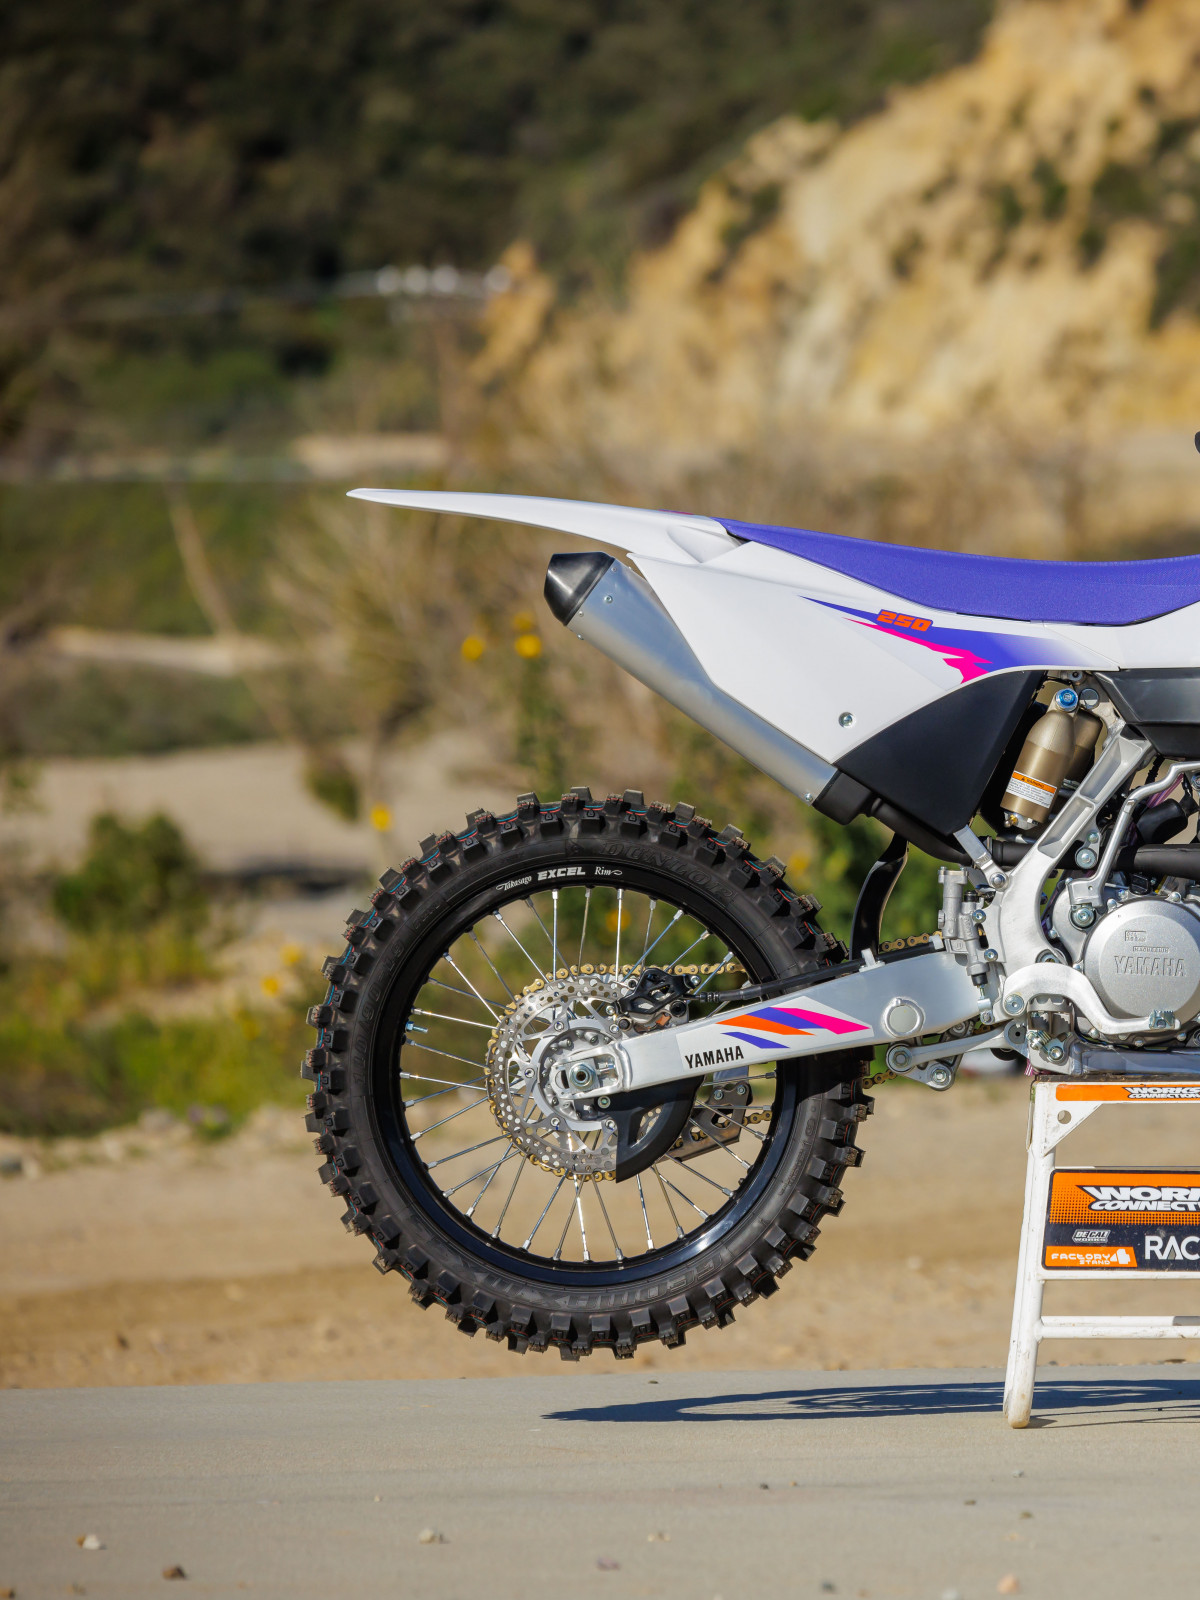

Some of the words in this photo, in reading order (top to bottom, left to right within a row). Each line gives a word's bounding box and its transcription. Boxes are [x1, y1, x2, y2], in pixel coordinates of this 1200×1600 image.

[876, 610, 932, 632] 250
[500, 875, 532, 891] Takasago
[537, 866, 586, 881] EXCEL
[595, 866, 614, 876] Rim
[600, 842, 738, 900] DUNLOP
[1113, 955, 1187, 977] YAMAHA
[684, 1045, 745, 1069] YAMAHA
